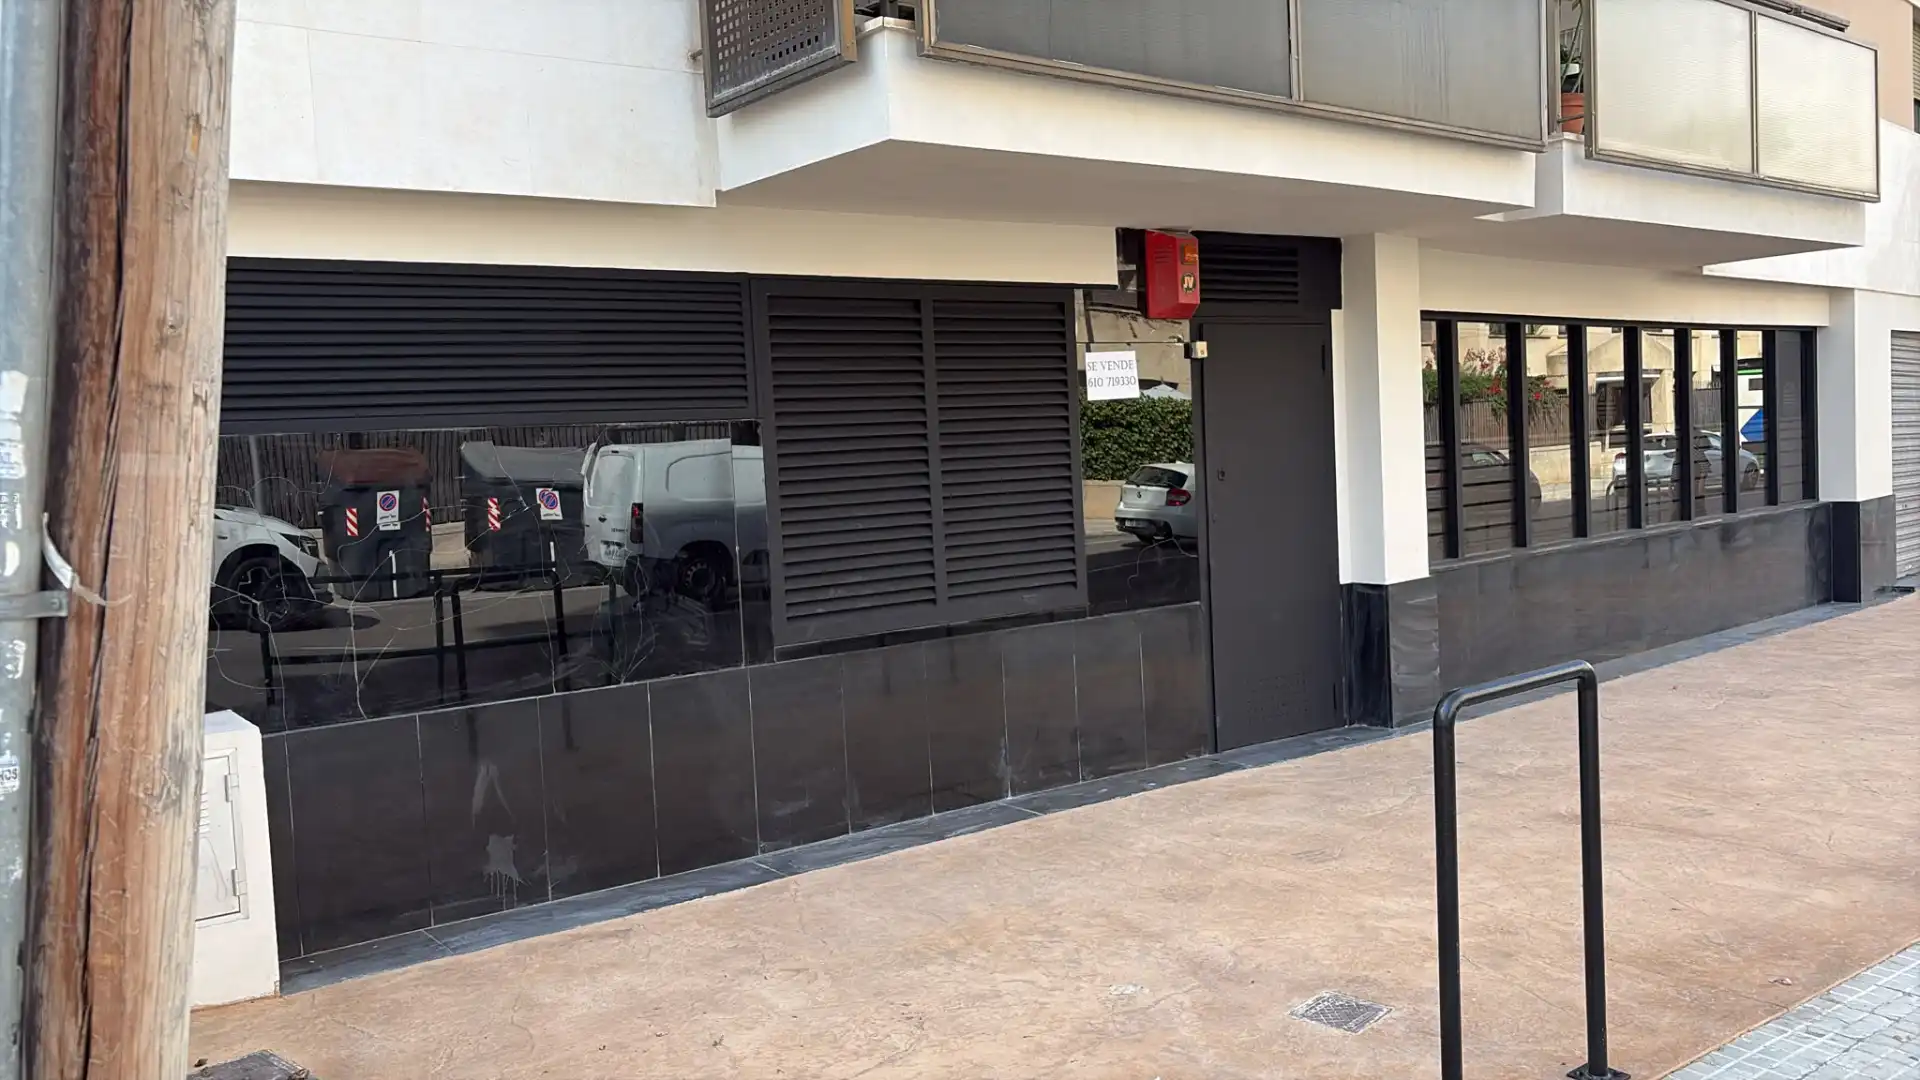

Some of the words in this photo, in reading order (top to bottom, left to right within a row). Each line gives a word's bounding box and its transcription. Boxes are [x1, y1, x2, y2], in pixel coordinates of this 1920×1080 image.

[1087, 361, 1098, 371] SE
[1100, 360, 1134, 371] VENDE
[1088, 377, 1104, 388] 610
[1106, 375, 1137, 387] 719330
